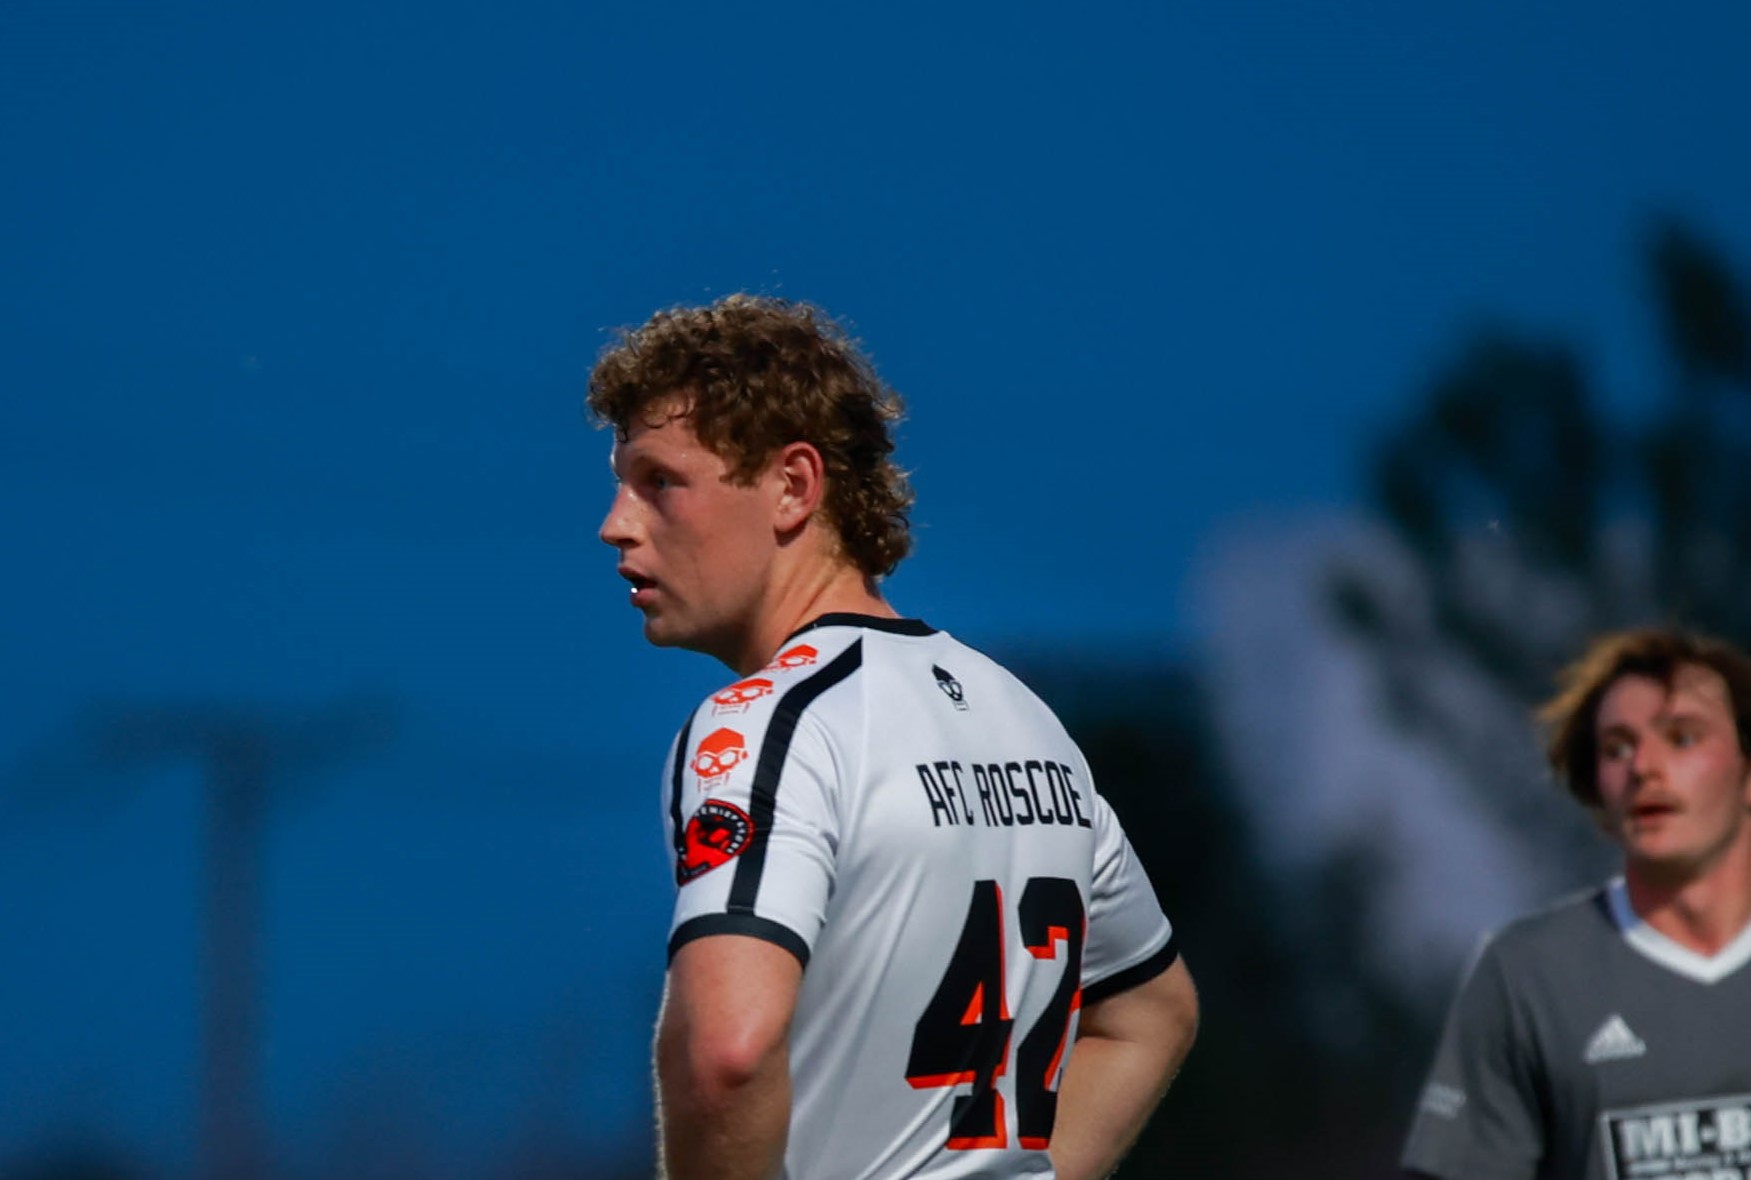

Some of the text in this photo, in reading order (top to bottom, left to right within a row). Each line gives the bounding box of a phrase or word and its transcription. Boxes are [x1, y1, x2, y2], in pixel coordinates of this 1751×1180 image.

[915, 760, 1093, 829] AFC ROSCOE
[904, 876, 1085, 1150] 42
